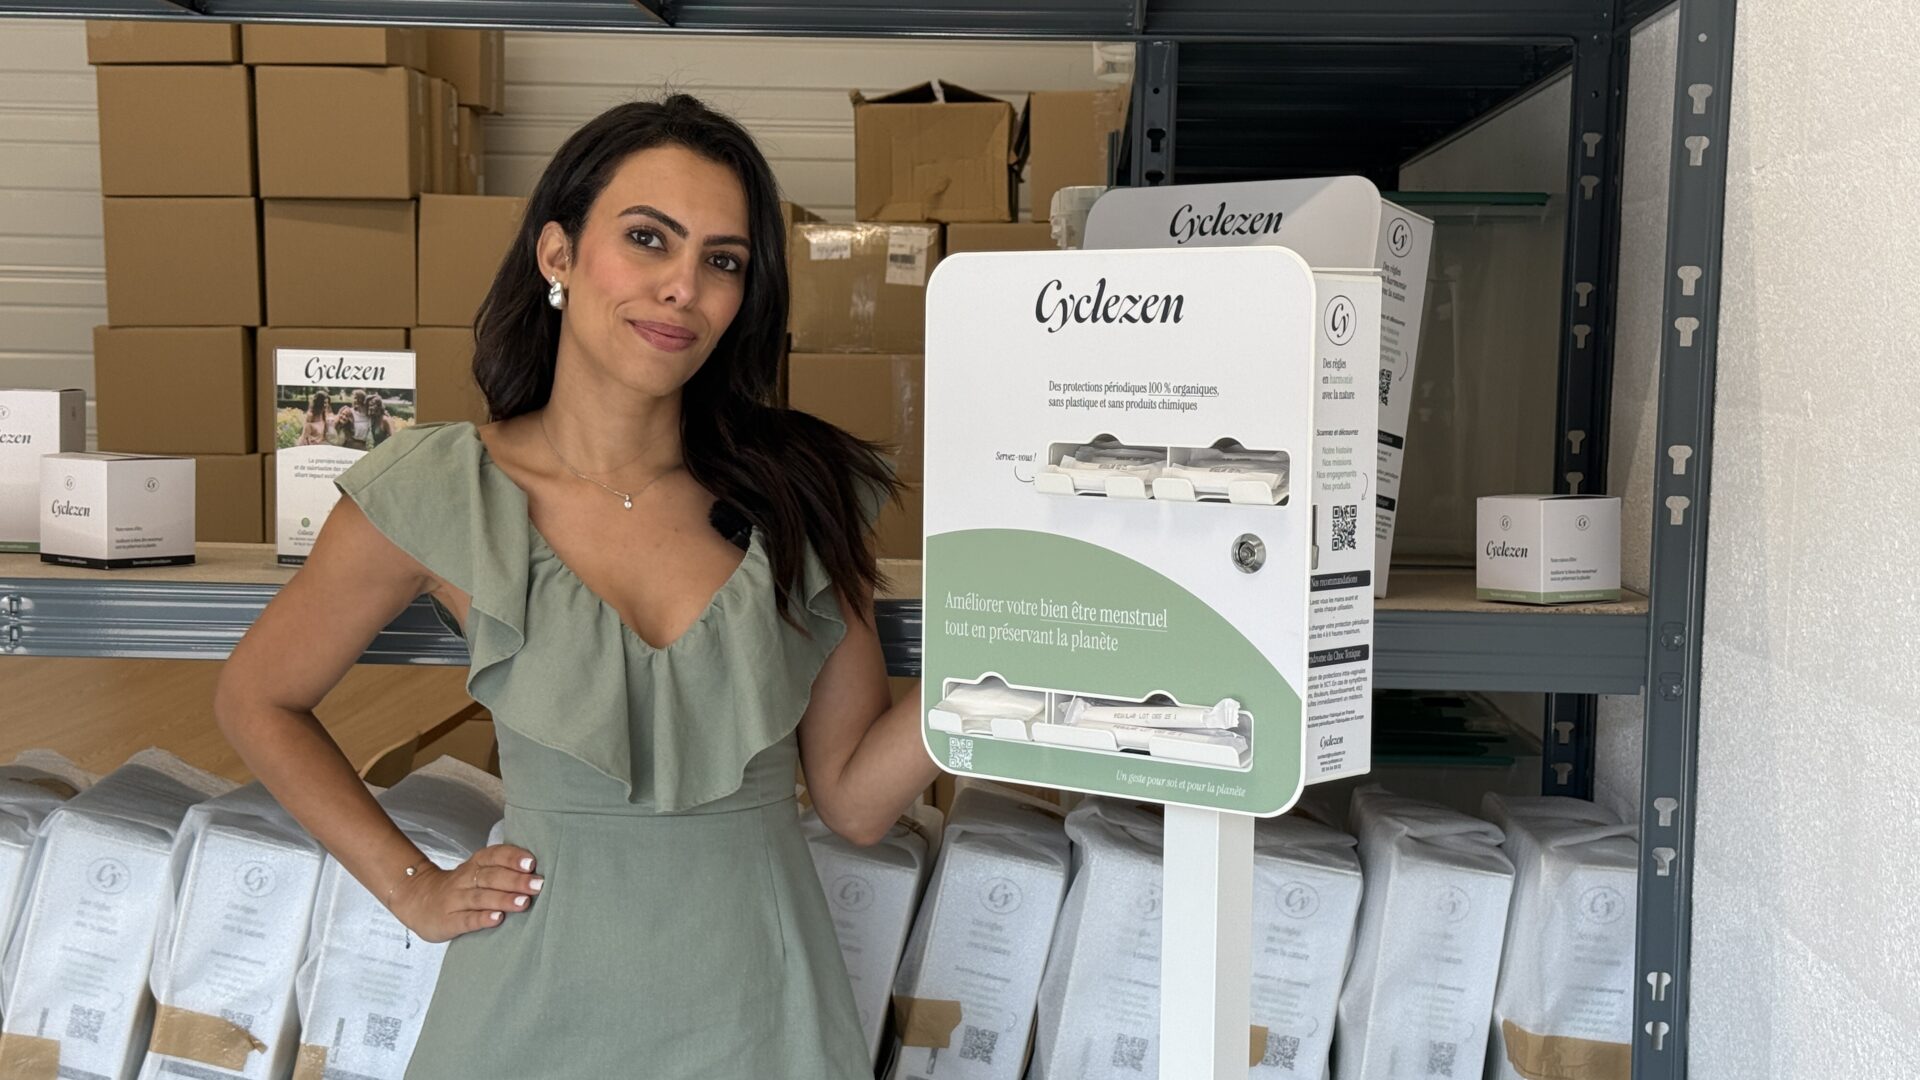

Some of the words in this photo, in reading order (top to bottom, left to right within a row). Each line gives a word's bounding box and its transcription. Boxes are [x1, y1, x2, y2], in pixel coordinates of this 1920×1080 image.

[1170, 201, 1283, 245] Cyclezen
[1035, 277, 1184, 333] Cyclezen
[304, 356, 386, 384] Cyclezen
[1322, 358, 1331, 368] Des
[1332, 358, 1346, 371] règles
[1329, 374, 1353, 384] harmonie
[1049, 380, 1062, 391] Des
[1063, 381, 1103, 394] protections
[1104, 382, 1147, 395] périodiques
[1148, 382, 1162, 394] 100
[1164, 382, 1171, 393] %
[1172, 383, 1219, 396] organiques,
[1322, 390, 1333, 399] avec
[1339, 390, 1355, 400] nature
[1048, 398, 1064, 408] sans
[1066, 397, 1098, 410] plastique
[1099, 399, 1106, 408] et
[1108, 400, 1124, 409] sans
[1125, 399, 1157, 411] produits
[1158, 400, 1197, 412] chimiques
[0, 429, 32, 444] ezen
[1332, 482, 1351, 492] produits
[51, 499, 91, 518] Cyclezen
[1486, 540, 1528, 559] Cyclezen
[945, 591, 1002, 612] Améliorer
[1007, 599, 1038, 616] votre
[1040, 599, 1068, 619] bien
[1071, 601, 1097, 621] être
[1100, 608, 1168, 628] menstruel
[945, 619, 969, 637] tout
[971, 624, 986, 638] en
[989, 623, 1053, 643] préservant
[1057, 628, 1068, 646] la
[1071, 630, 1118, 652] planète
[1320, 734, 1344, 750] Cyclezen
[1116, 769, 1127, 782] Un
[1128, 773, 1146, 784] geste
[1146, 775, 1166, 787] pour
[1166, 776, 1178, 787] soi
[1178, 778, 1186, 789] et
[1186, 780, 1206, 792] pour
[1206, 781, 1215, 793] la
[1216, 784, 1246, 797] planète
